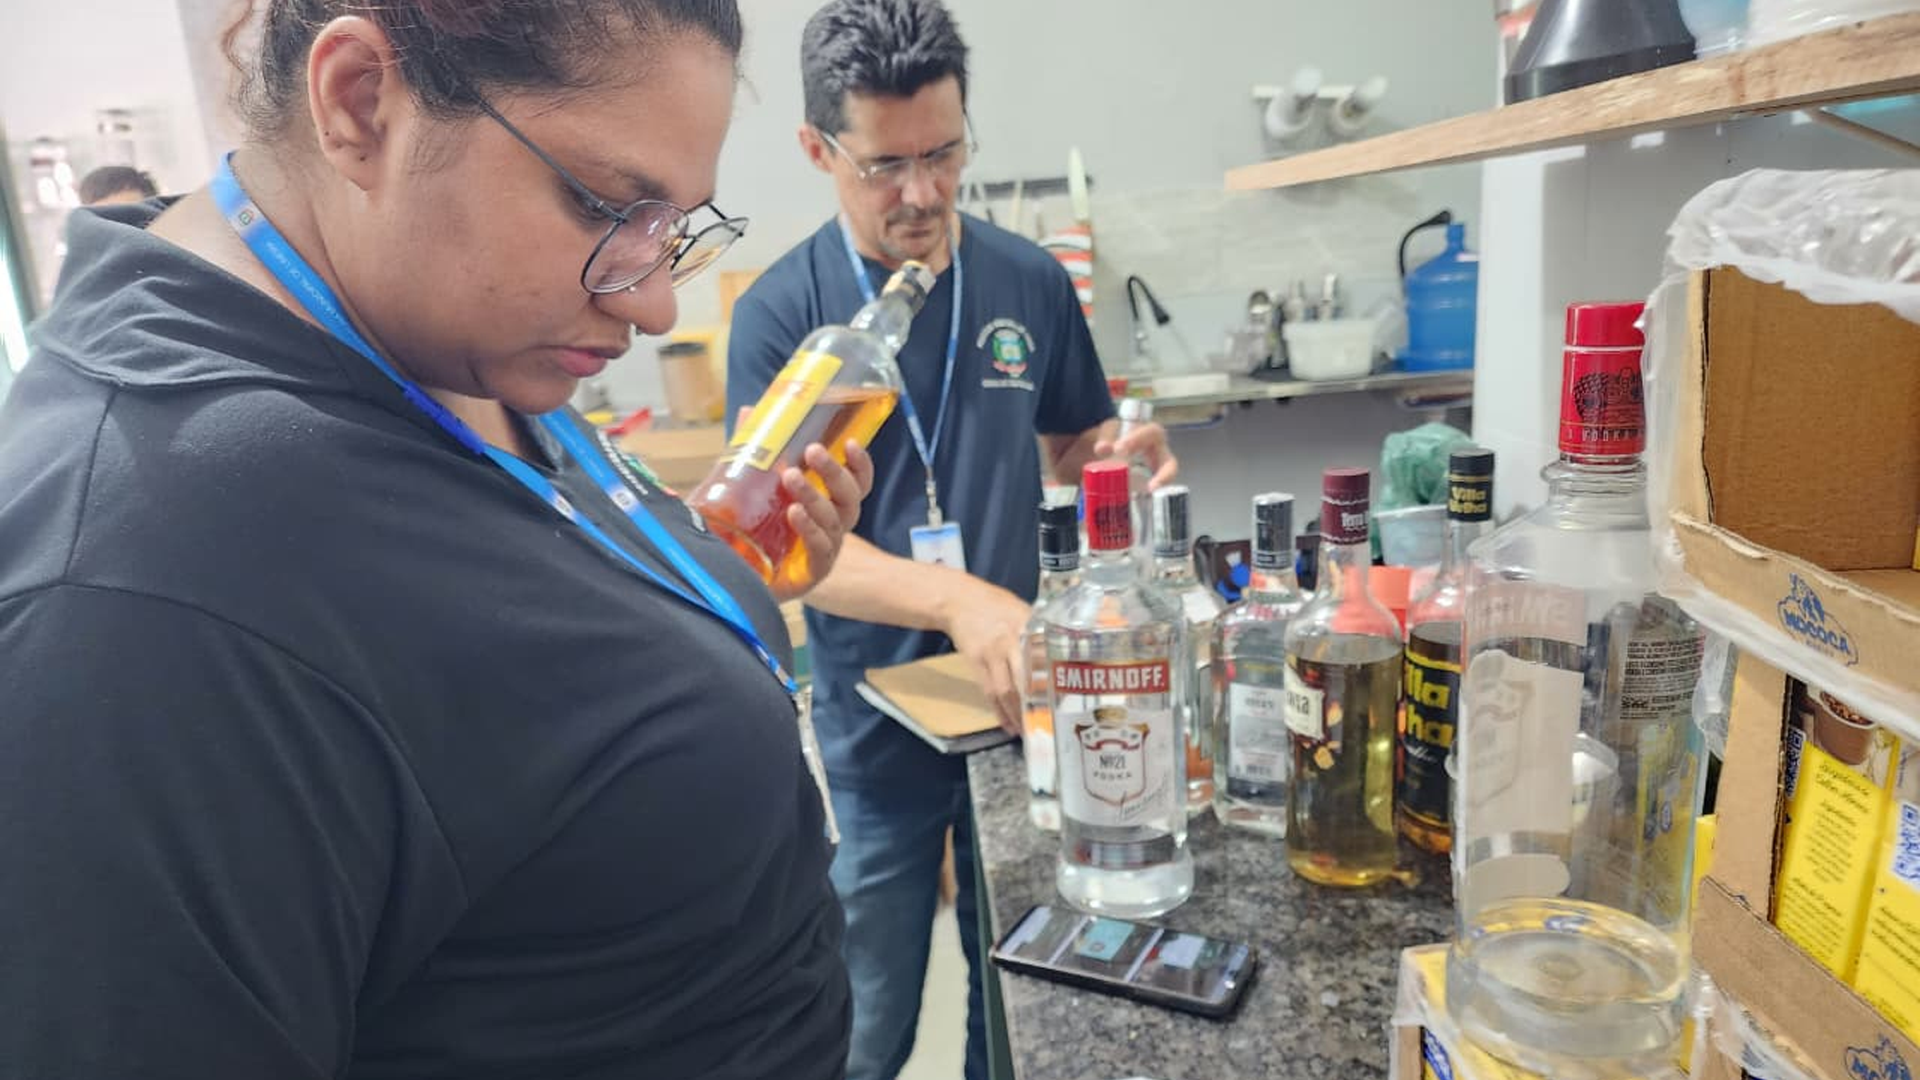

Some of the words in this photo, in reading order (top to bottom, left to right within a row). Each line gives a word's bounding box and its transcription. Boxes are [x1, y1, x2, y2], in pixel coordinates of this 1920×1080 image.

[1451, 486, 1486, 500] Villa
[1783, 608, 1850, 654] MOCOCA
[1056, 665, 1164, 690] SMIRNOFF
